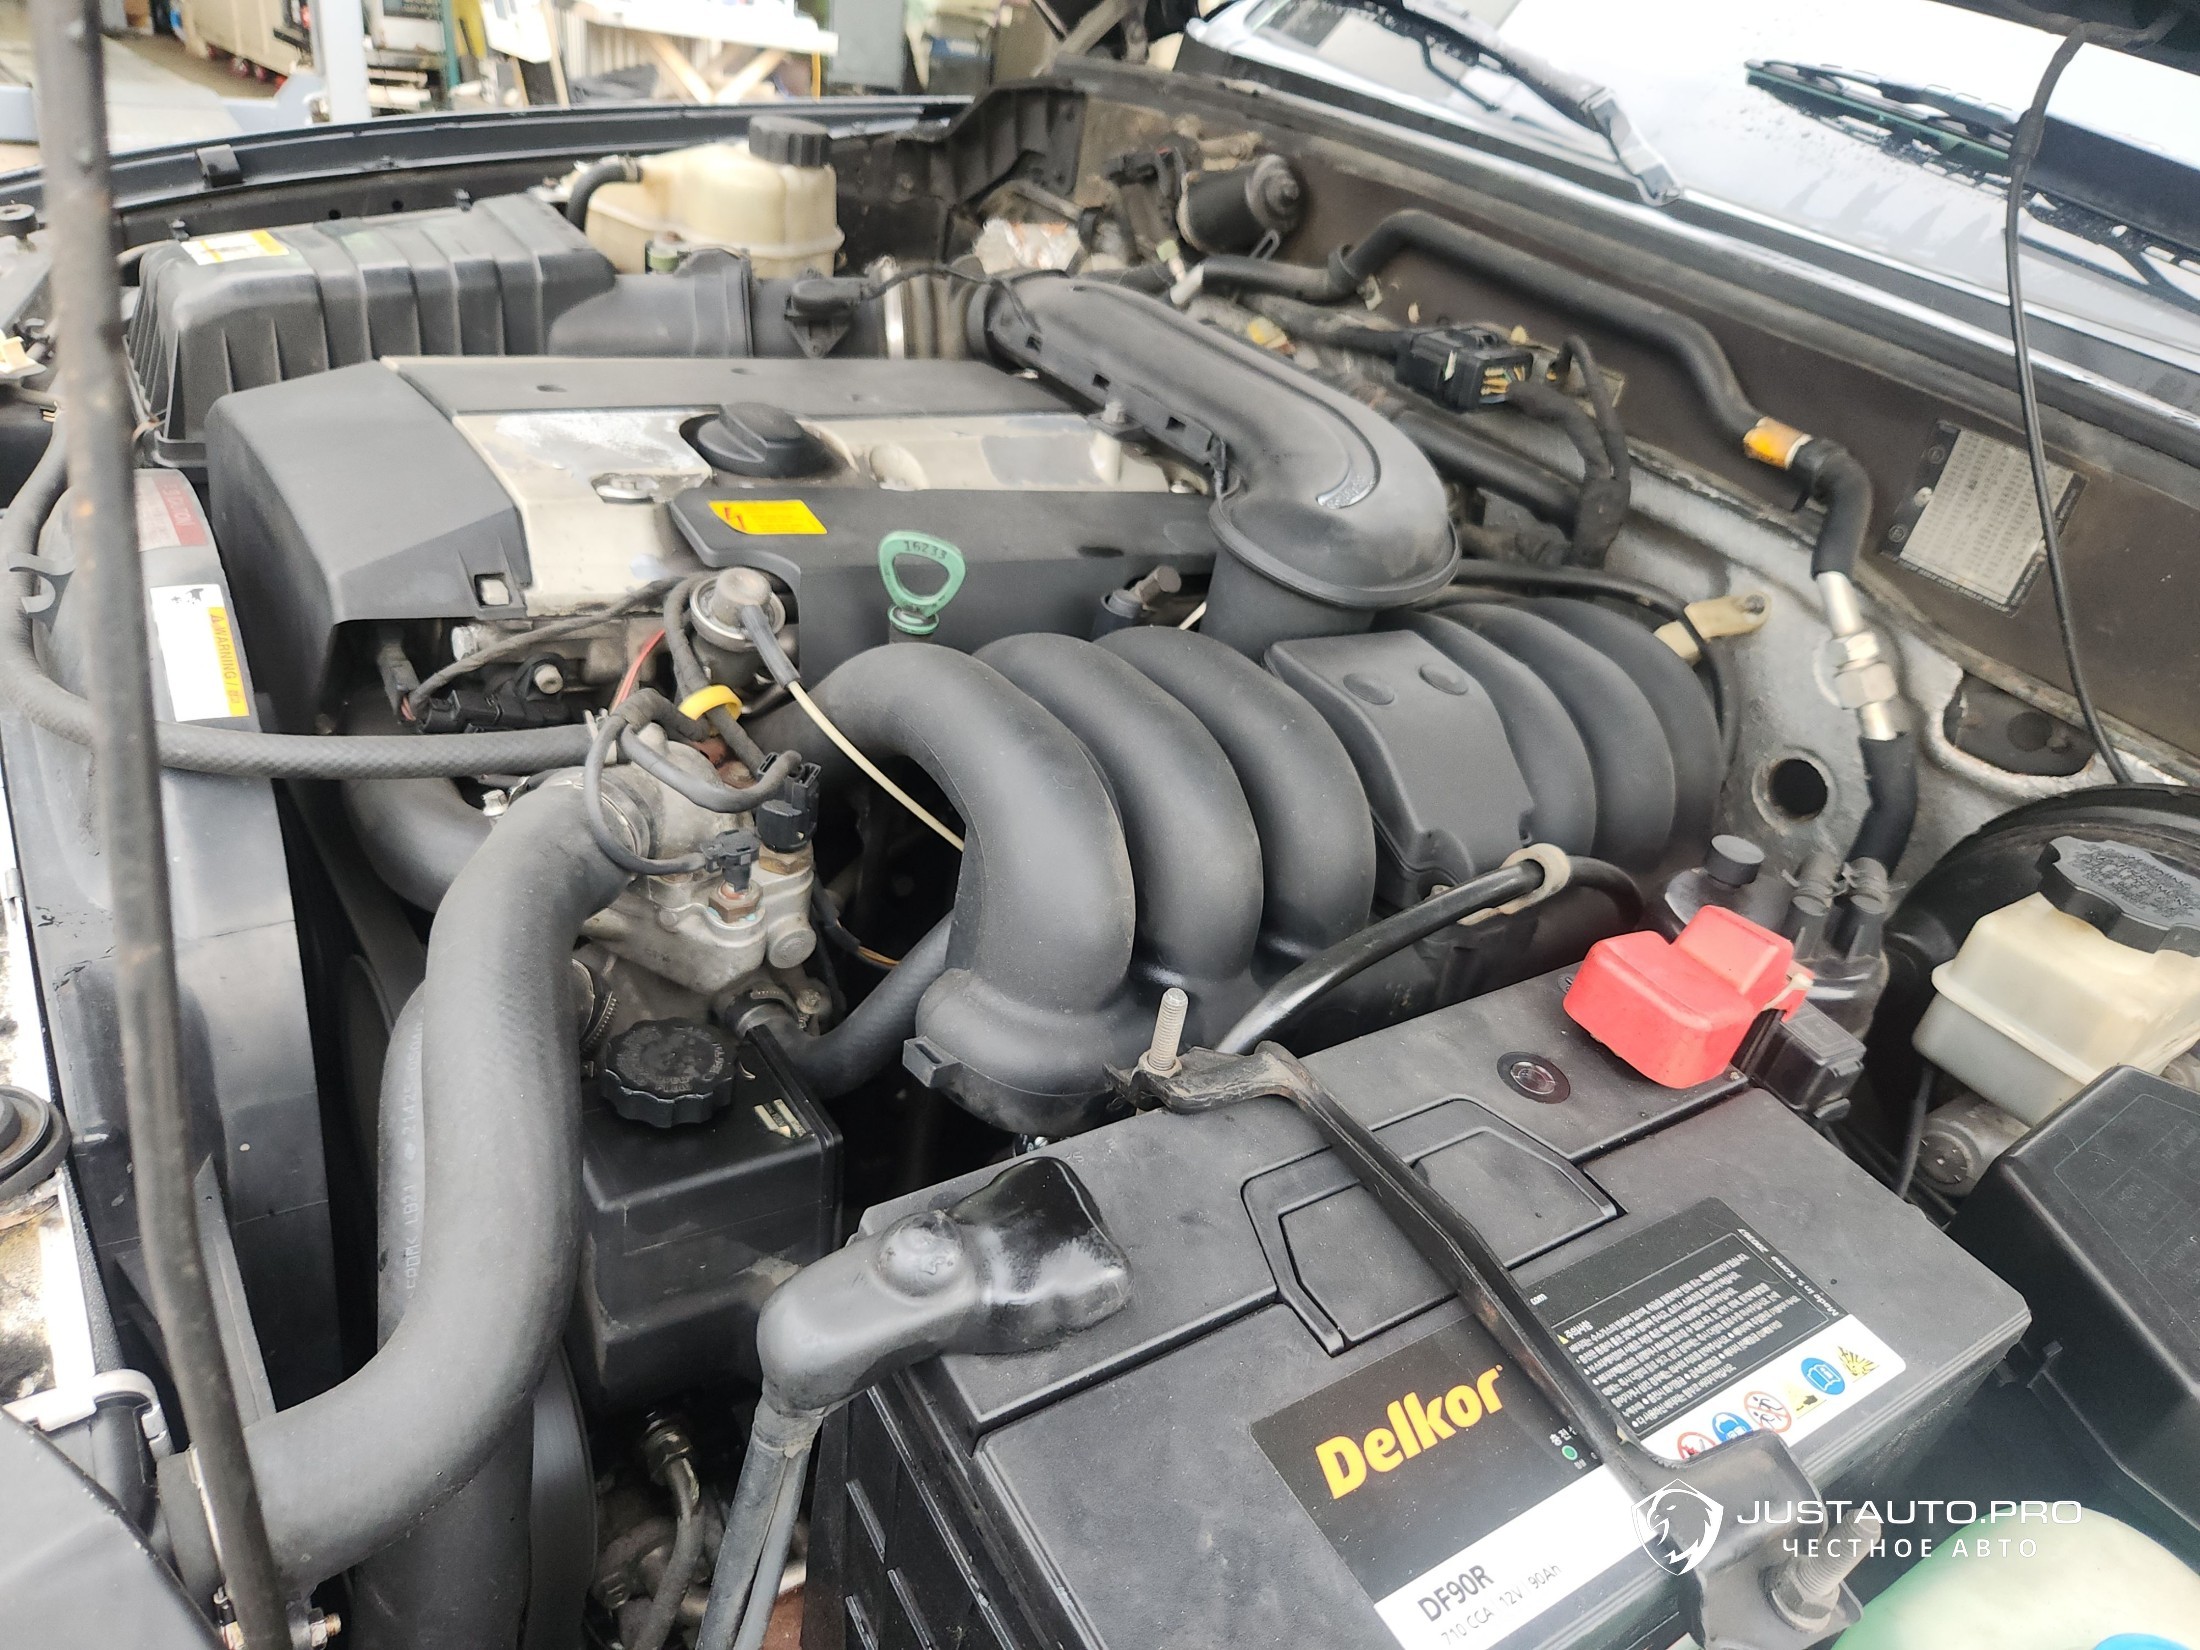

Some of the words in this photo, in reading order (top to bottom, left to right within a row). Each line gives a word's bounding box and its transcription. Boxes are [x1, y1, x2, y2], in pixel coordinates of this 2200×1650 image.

[904, 540, 947, 560] 16233
[215, 628, 236, 680] WARNING
[1315, 1366, 1503, 1499] Delkor
[1417, 1564, 1494, 1621] DF90R
[1441, 1622, 1467, 1645] 710
[1466, 1606, 1494, 1630] CCA
[1499, 1586, 1523, 1608] 12V
[1528, 1562, 1562, 1590] 90Ah
